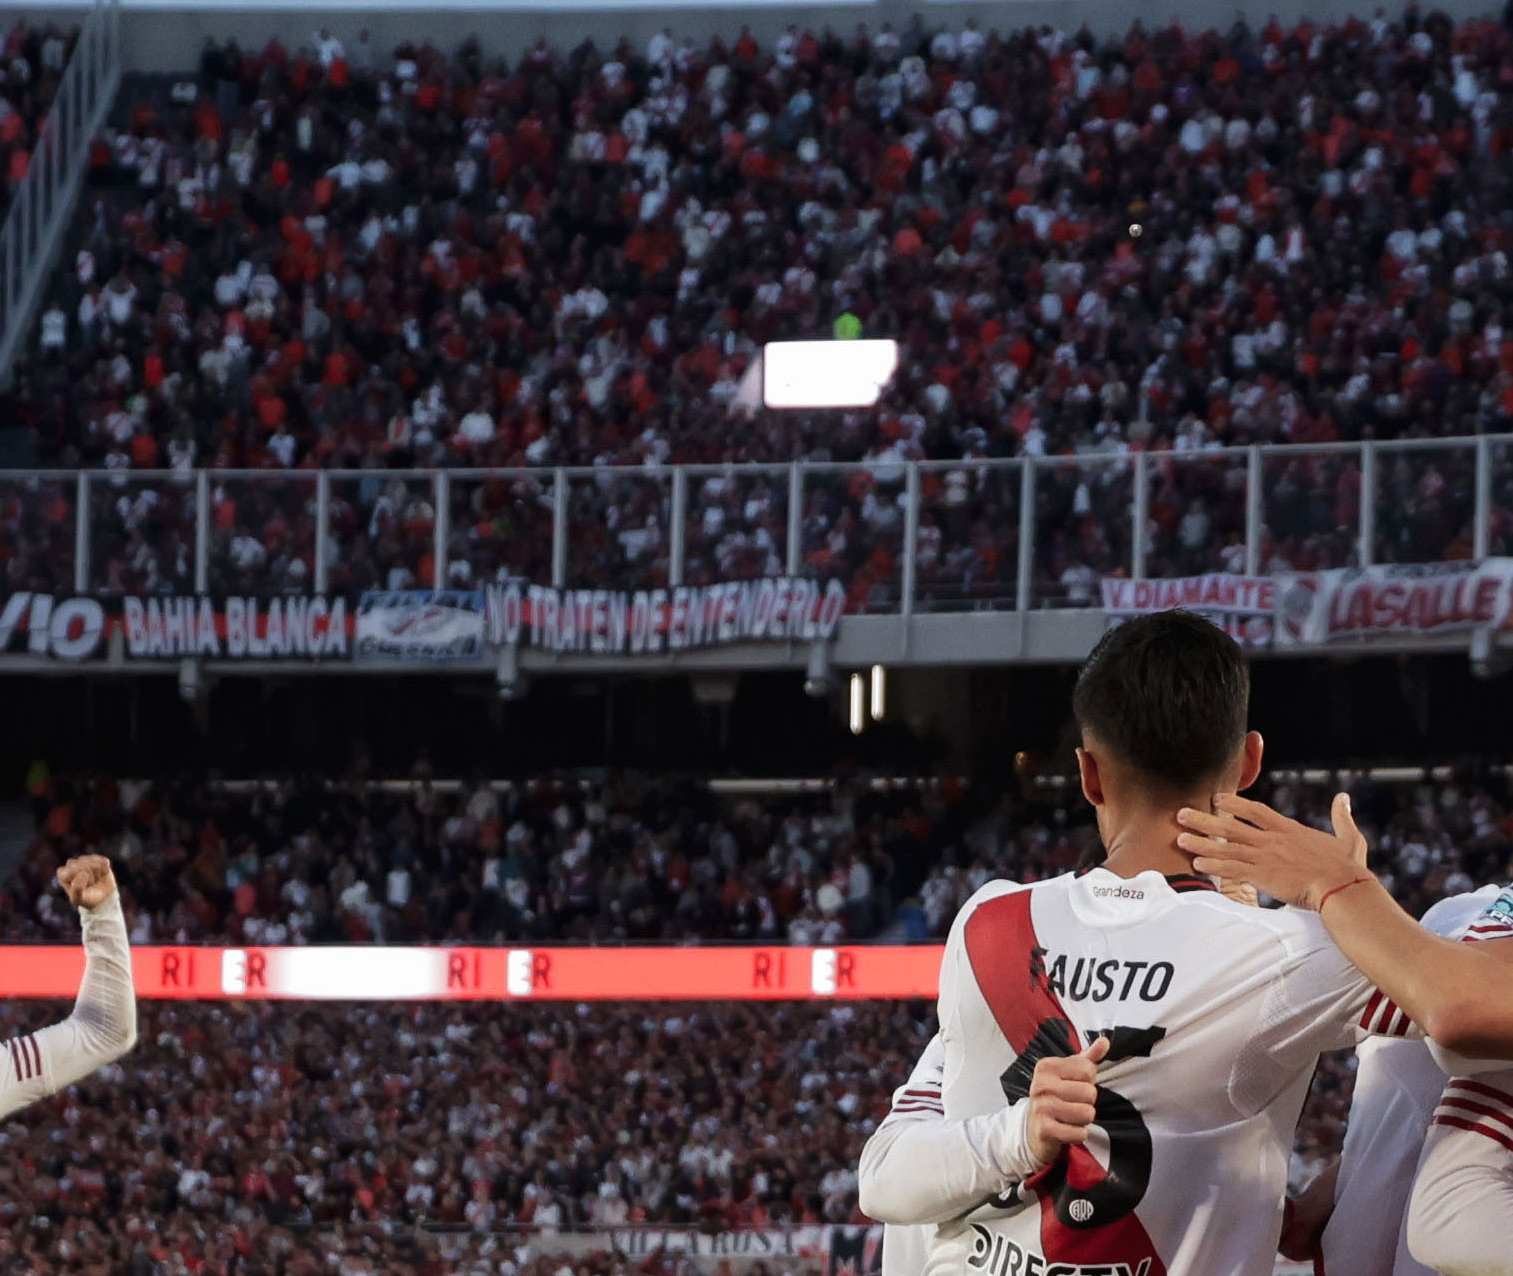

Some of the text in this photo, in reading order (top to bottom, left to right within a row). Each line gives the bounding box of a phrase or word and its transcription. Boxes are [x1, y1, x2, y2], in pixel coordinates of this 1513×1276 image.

[123, 594, 347, 658] BAHIA BLANCA
[1093, 886, 1145, 900] Grandeza
[1030, 947, 1176, 1003] FAUSTO
